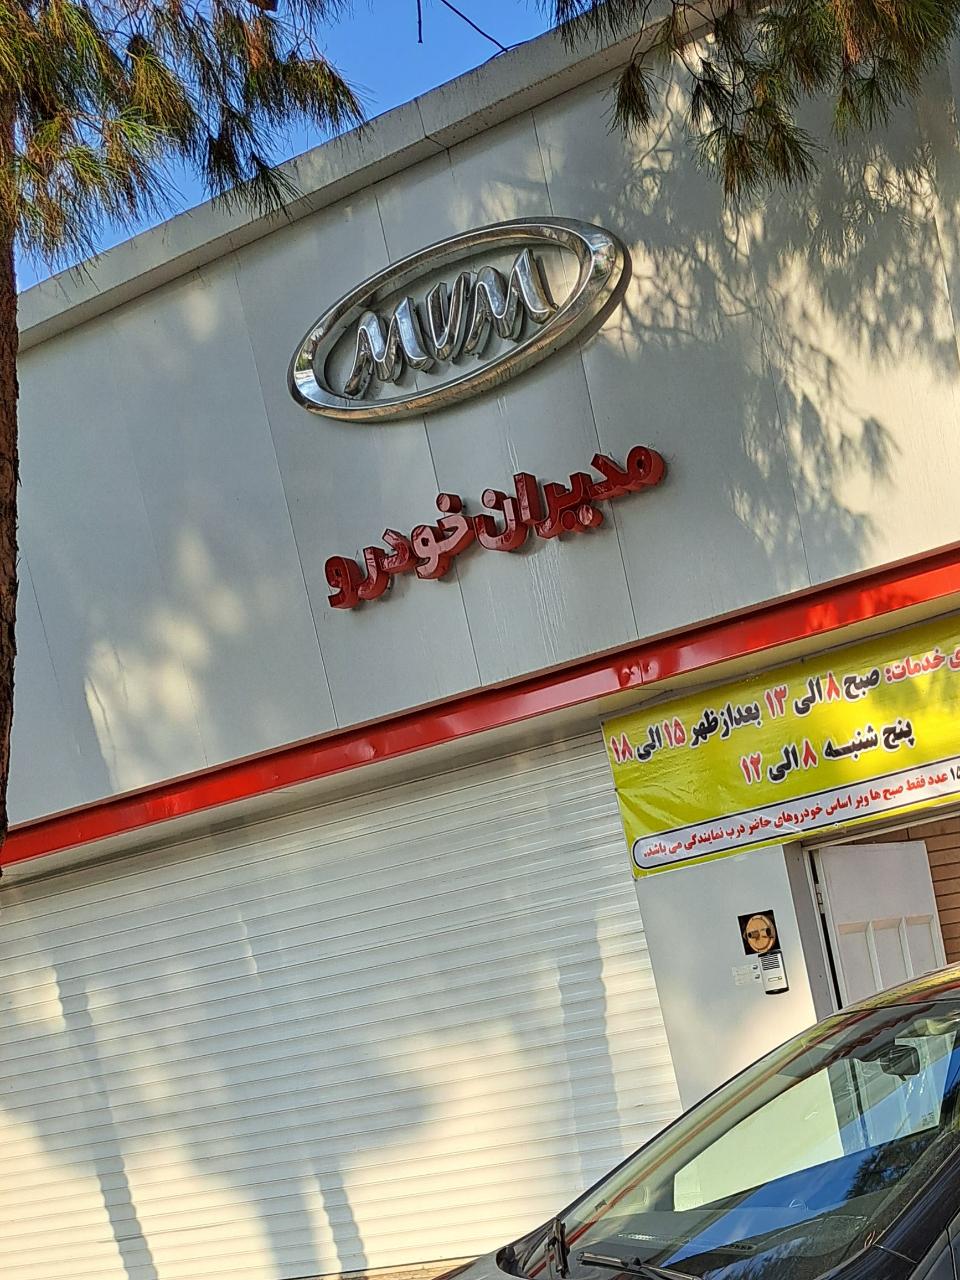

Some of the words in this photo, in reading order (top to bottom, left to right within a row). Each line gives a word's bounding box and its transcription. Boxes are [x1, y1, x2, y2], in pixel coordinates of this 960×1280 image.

[475, 445, 668, 553] مدیران
[324, 492, 477, 610] خودرو
[793, 676, 824, 716] الی
[843, 668, 880, 700] صبح
[636, 724, 663, 762] الی
[882, 719, 915, 750] پنج
[767, 744, 800, 783] الی
[927, 773, 949, 786] عدد
[905, 774, 926, 792] فقط
[825, 794, 853, 817] اساس
